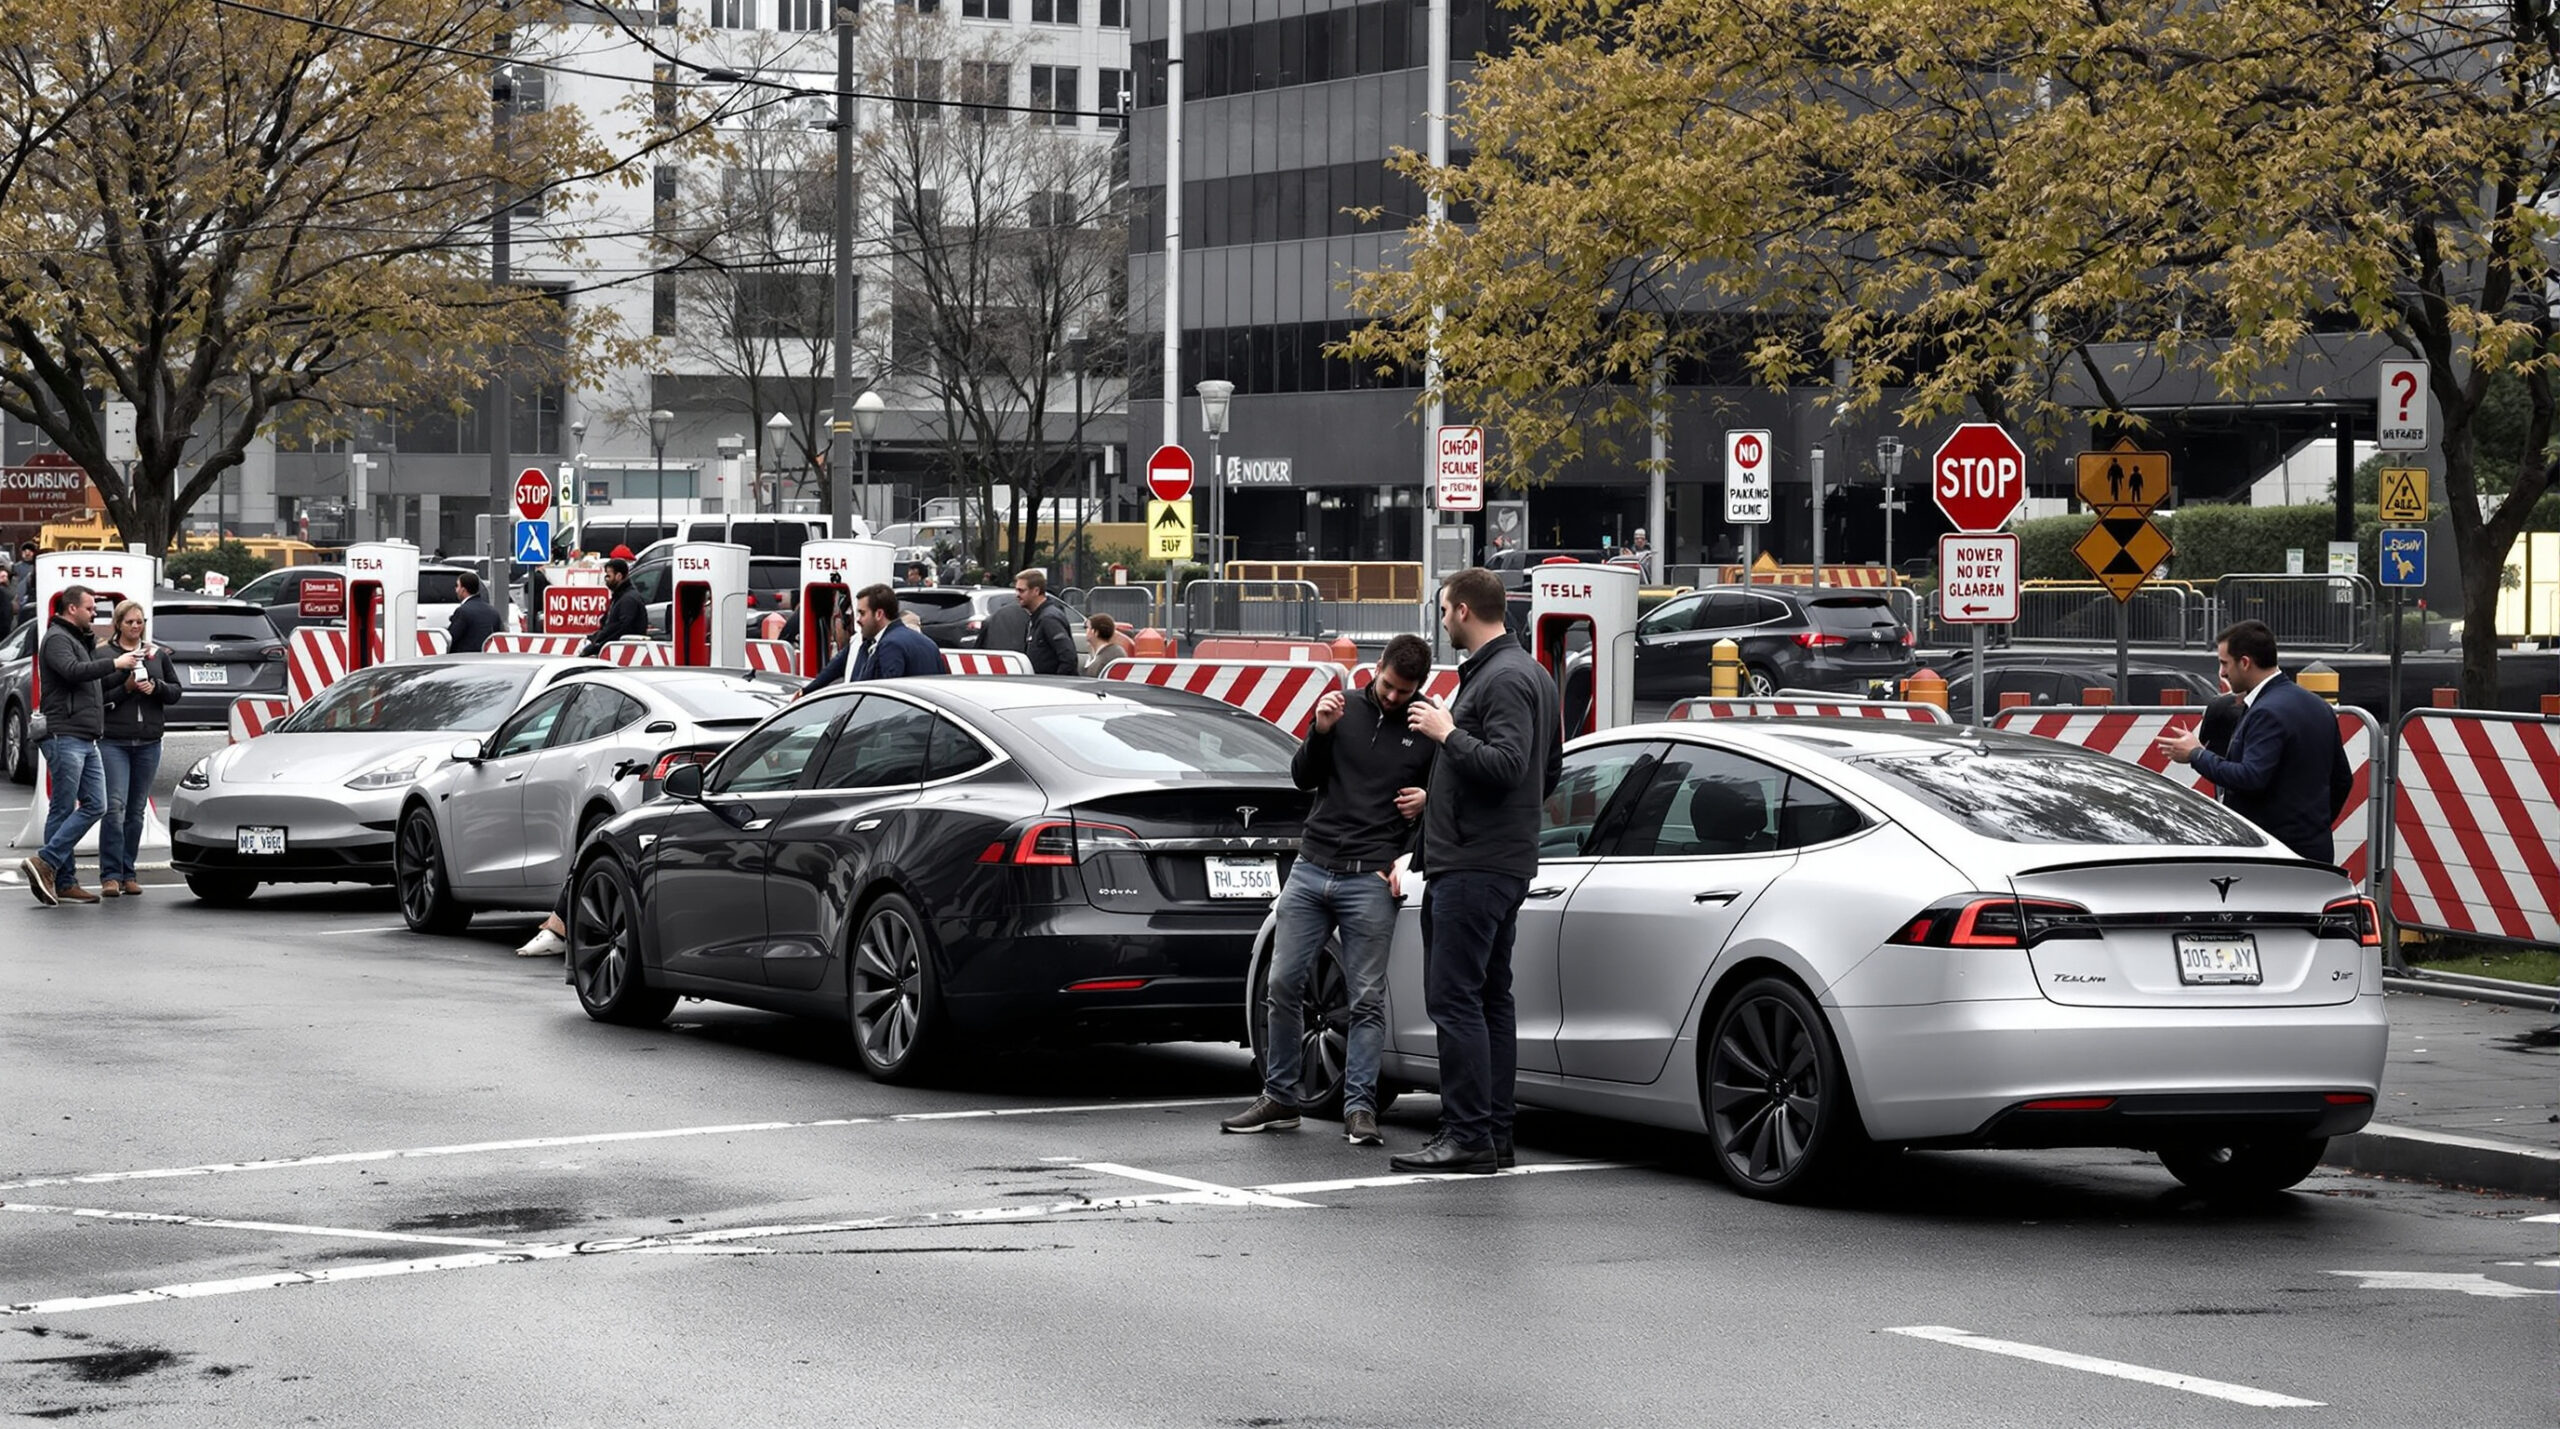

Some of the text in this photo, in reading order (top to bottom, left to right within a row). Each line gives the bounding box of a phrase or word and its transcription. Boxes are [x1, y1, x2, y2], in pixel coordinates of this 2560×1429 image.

[1739, 443, 1759, 462] NO
[1743, 472, 1755, 484] NO
[1941, 457, 2017, 499] STOP
[517, 485, 549, 505] STOP
[1957, 548, 2003, 561] NOWER
[1957, 565, 1973, 578] NO
[549, 595, 568, 611] NO
[549, 614, 564, 626] NO
